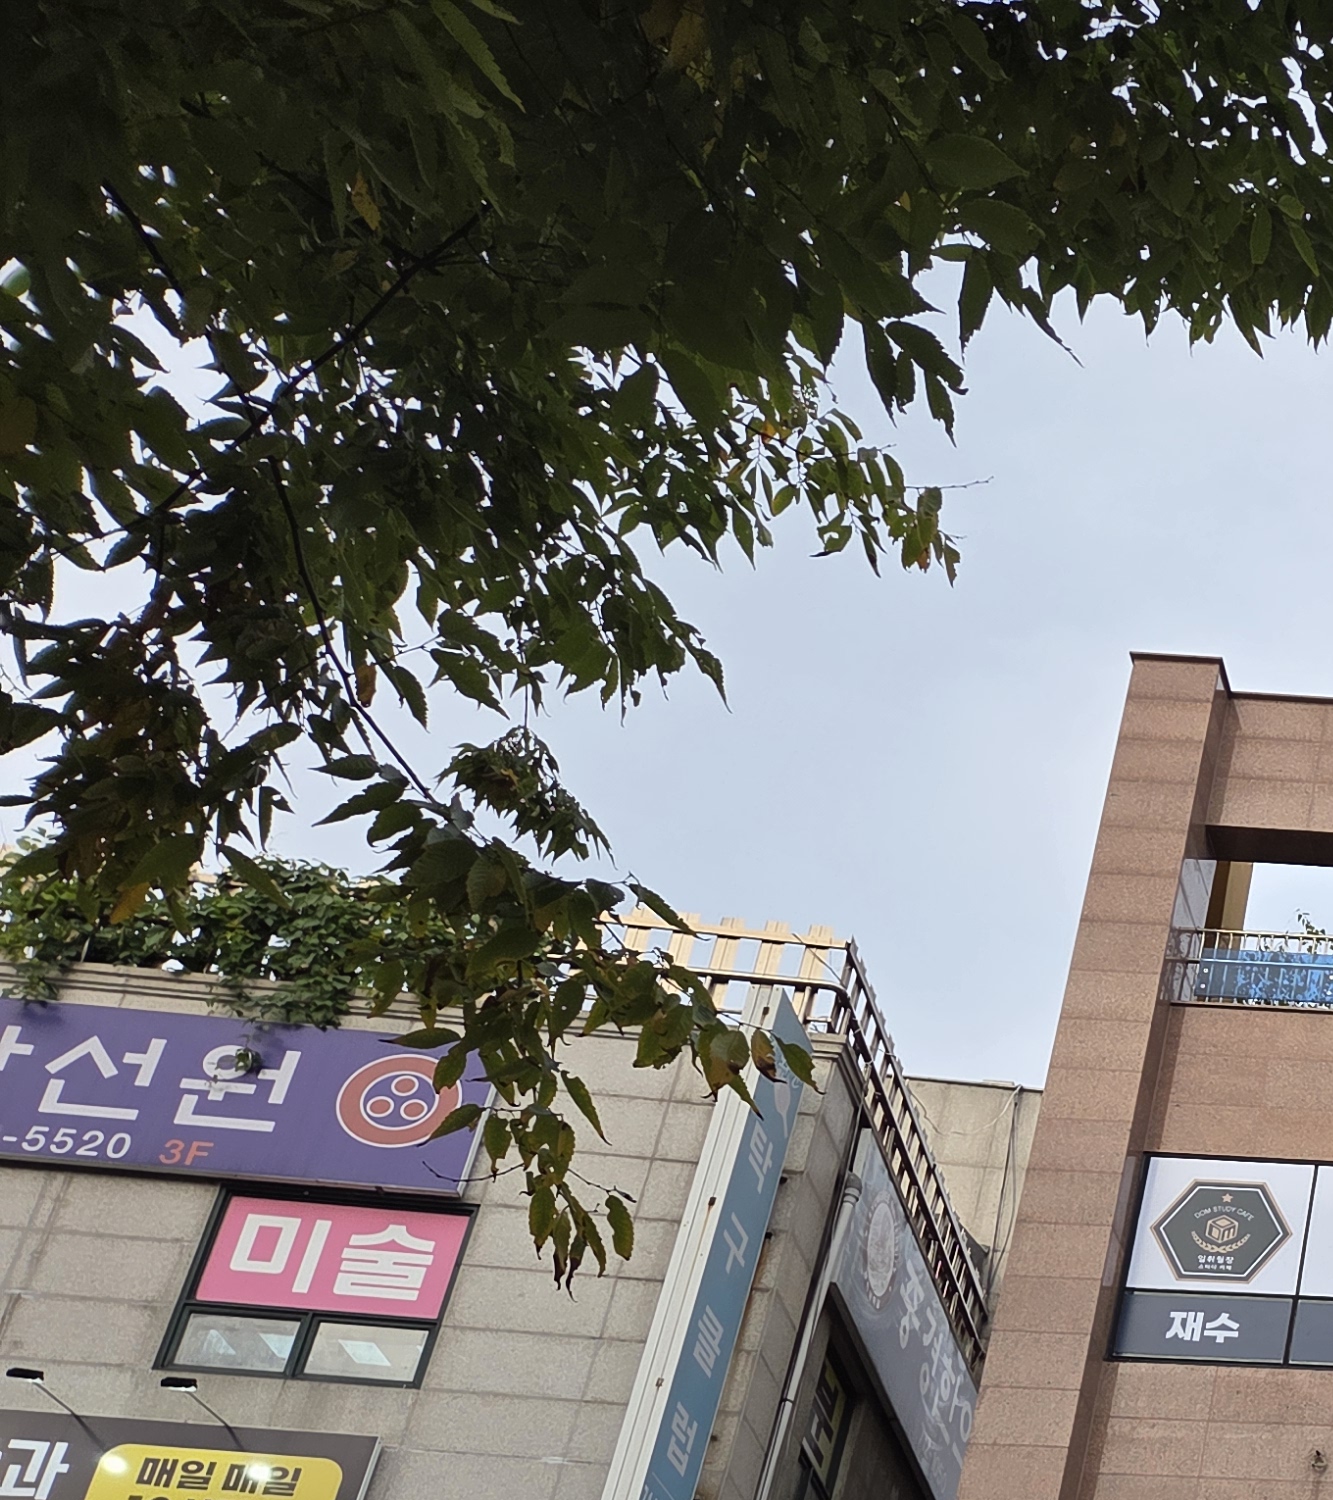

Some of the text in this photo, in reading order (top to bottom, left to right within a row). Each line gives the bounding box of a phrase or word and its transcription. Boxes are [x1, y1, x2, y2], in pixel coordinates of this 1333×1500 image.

[159, 1139, 214, 1166] 3F
[1213, 1205, 1236, 1213] STUDY
[229, 1213, 436, 1300] 미술
[1165, 1310, 1240, 1344] 재수
[136, 1457, 303, 1498] 매일 매일
